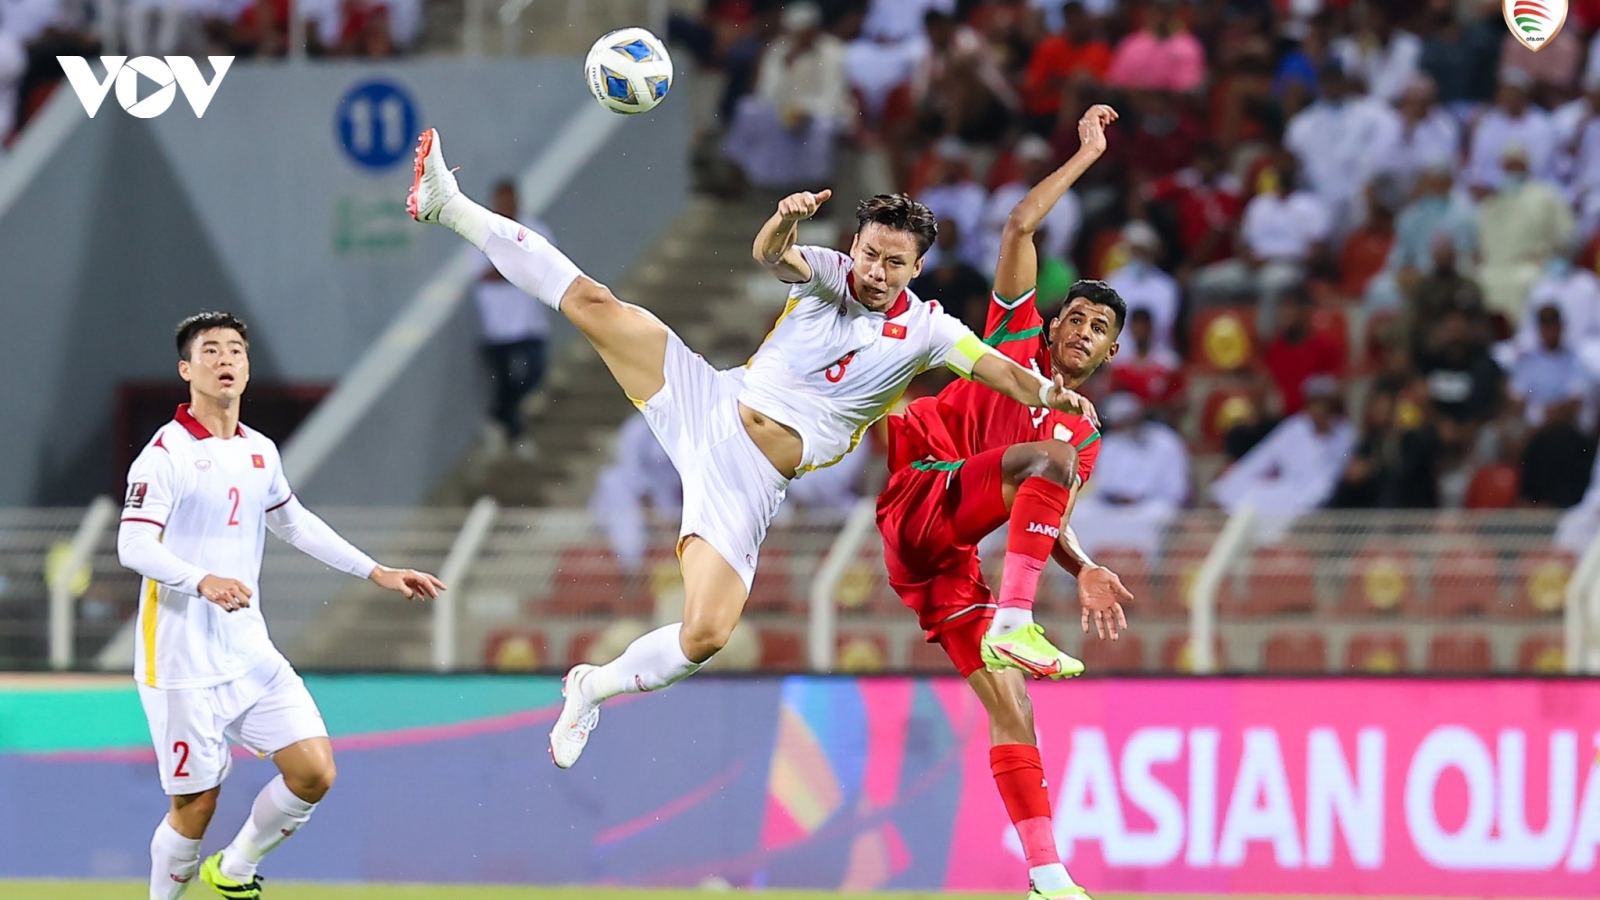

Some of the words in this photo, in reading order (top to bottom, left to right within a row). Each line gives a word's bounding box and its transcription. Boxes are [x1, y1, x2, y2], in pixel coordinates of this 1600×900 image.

[350, 97, 404, 156] 11
[227, 486, 240, 526] 2
[1026, 521, 1060, 539] JAKO
[173, 741, 189, 777] 2
[1053, 726, 1386, 869] ASIAN
